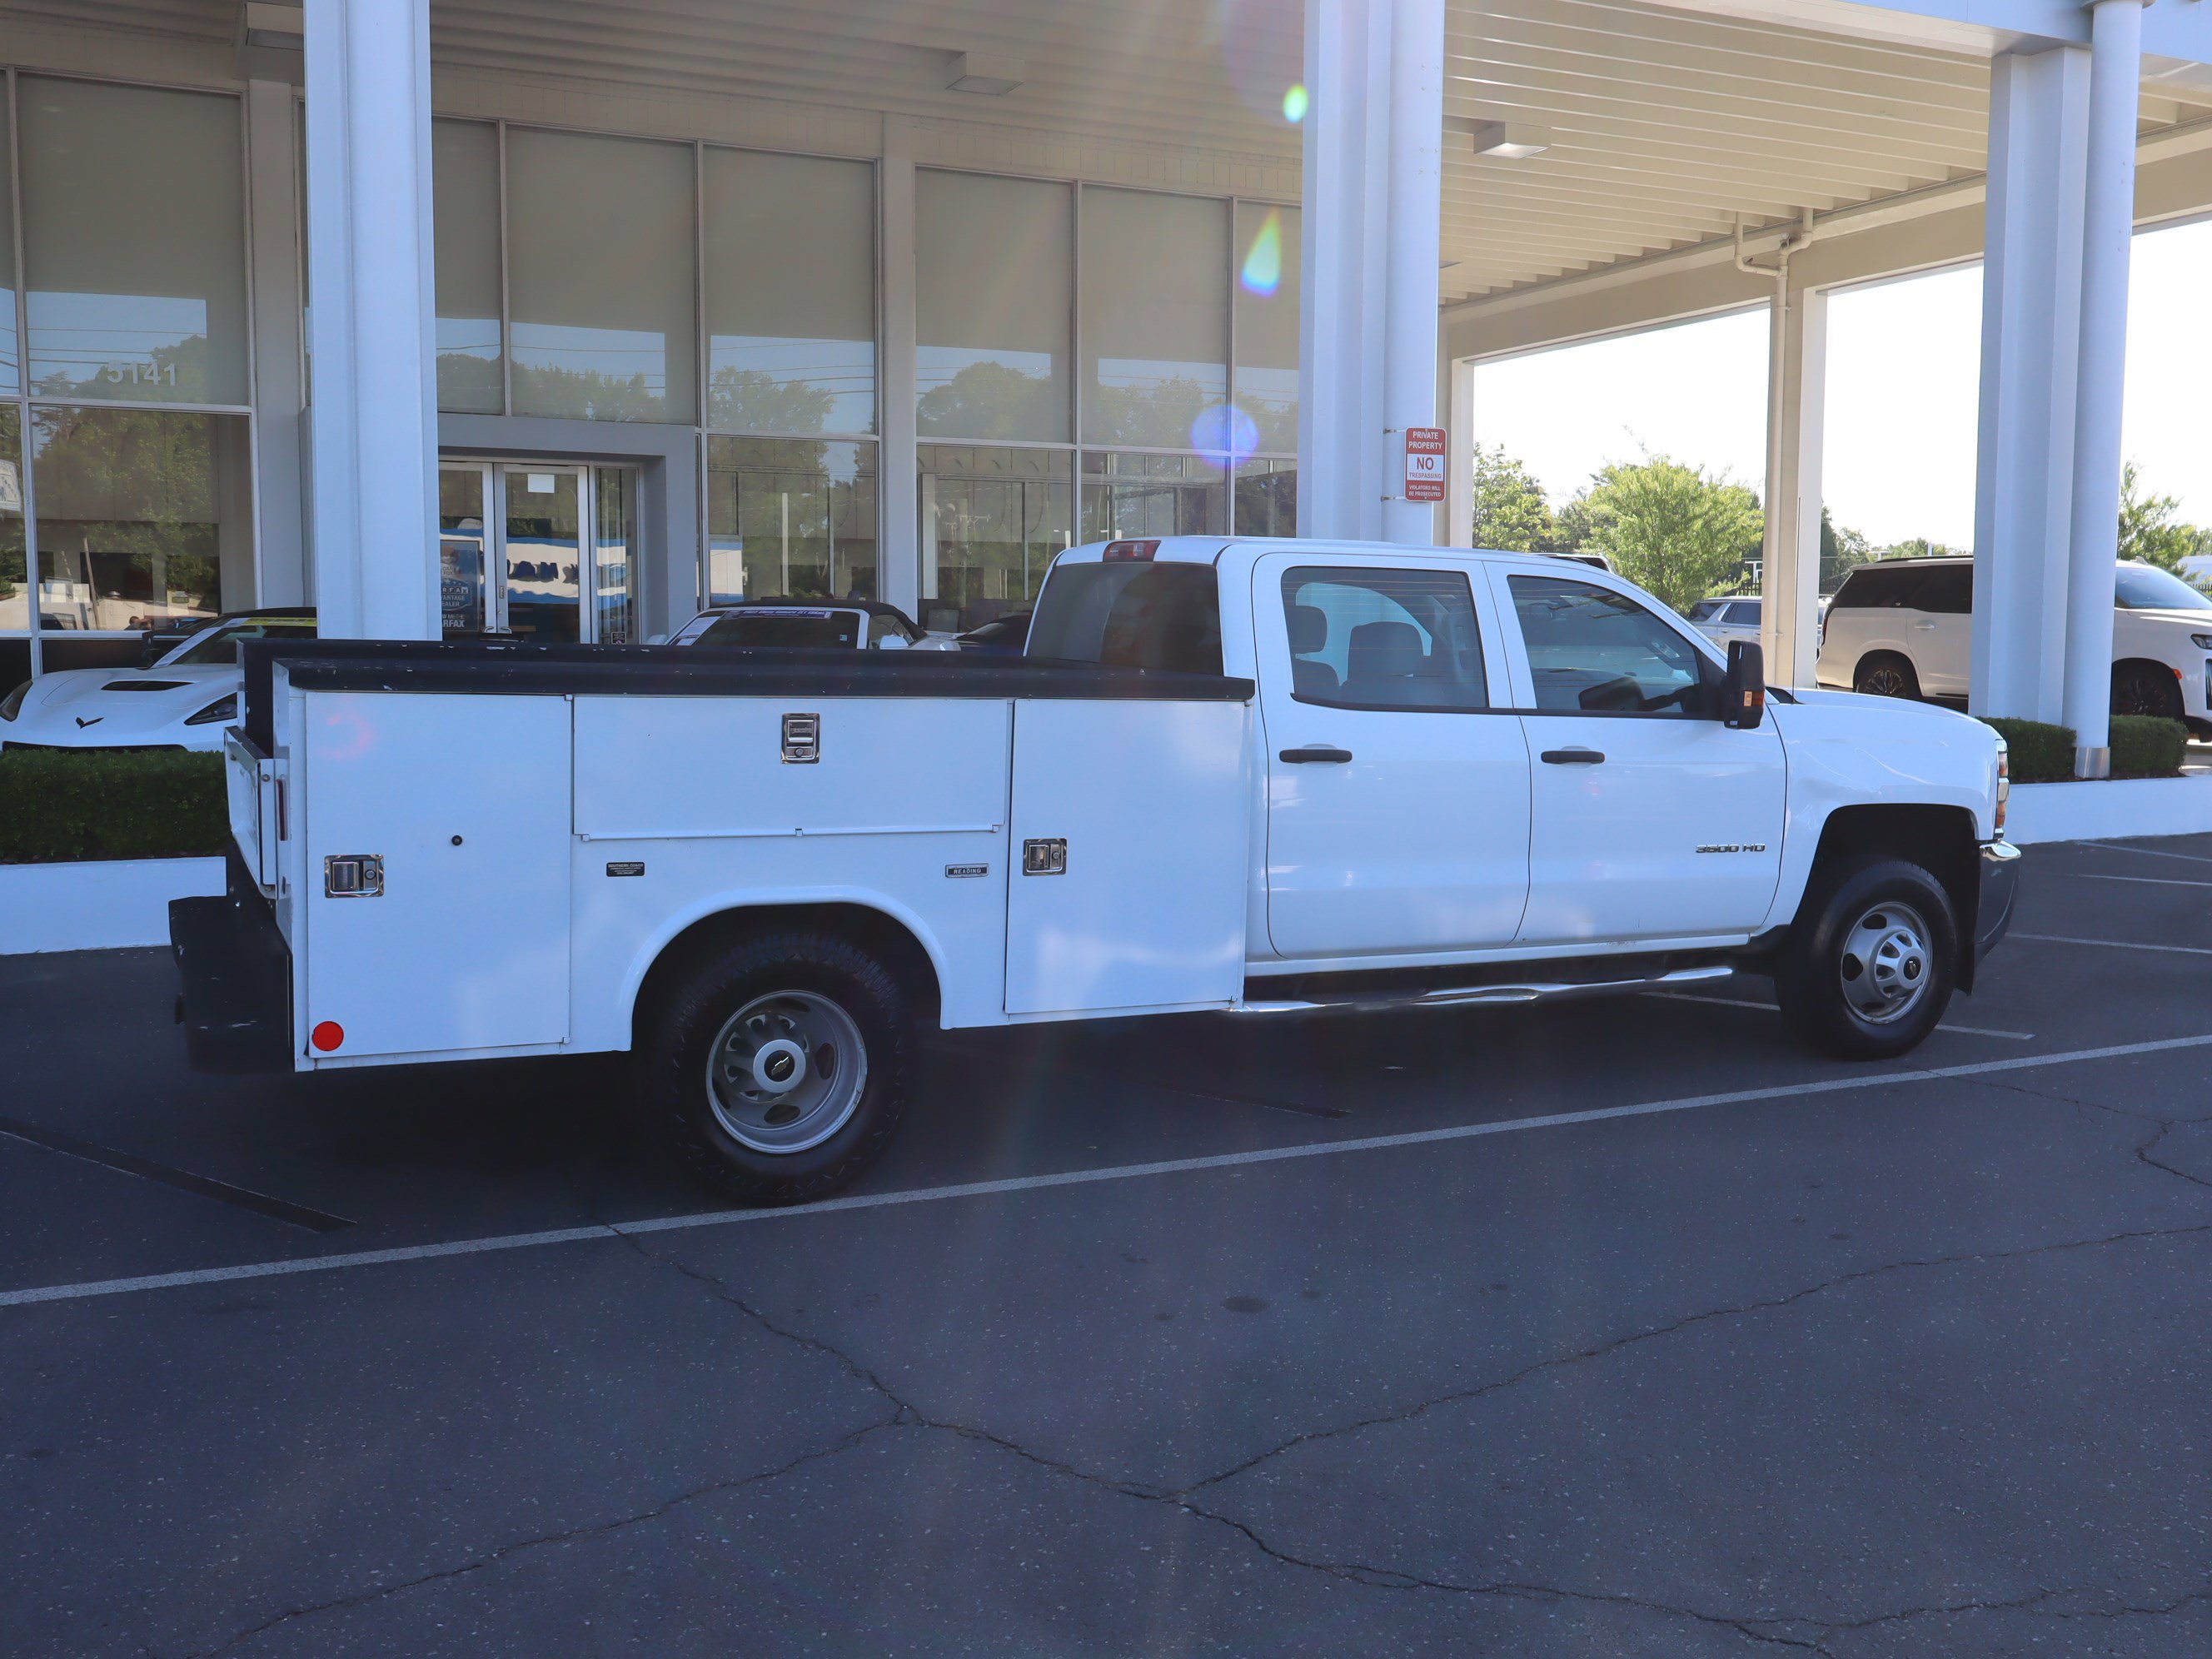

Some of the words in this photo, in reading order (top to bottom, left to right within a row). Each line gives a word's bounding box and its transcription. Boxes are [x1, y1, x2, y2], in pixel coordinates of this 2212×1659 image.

[107, 360, 176, 386] 5141
[1412, 431, 1439, 440] PRIVATE
[1408, 441, 1442, 450] PROPERTY
[1417, 457, 1434, 471] NO
[443, 619, 466, 628] RFAX
[1696, 844, 1740, 854] 3500
[1742, 843, 1766, 852] HD
